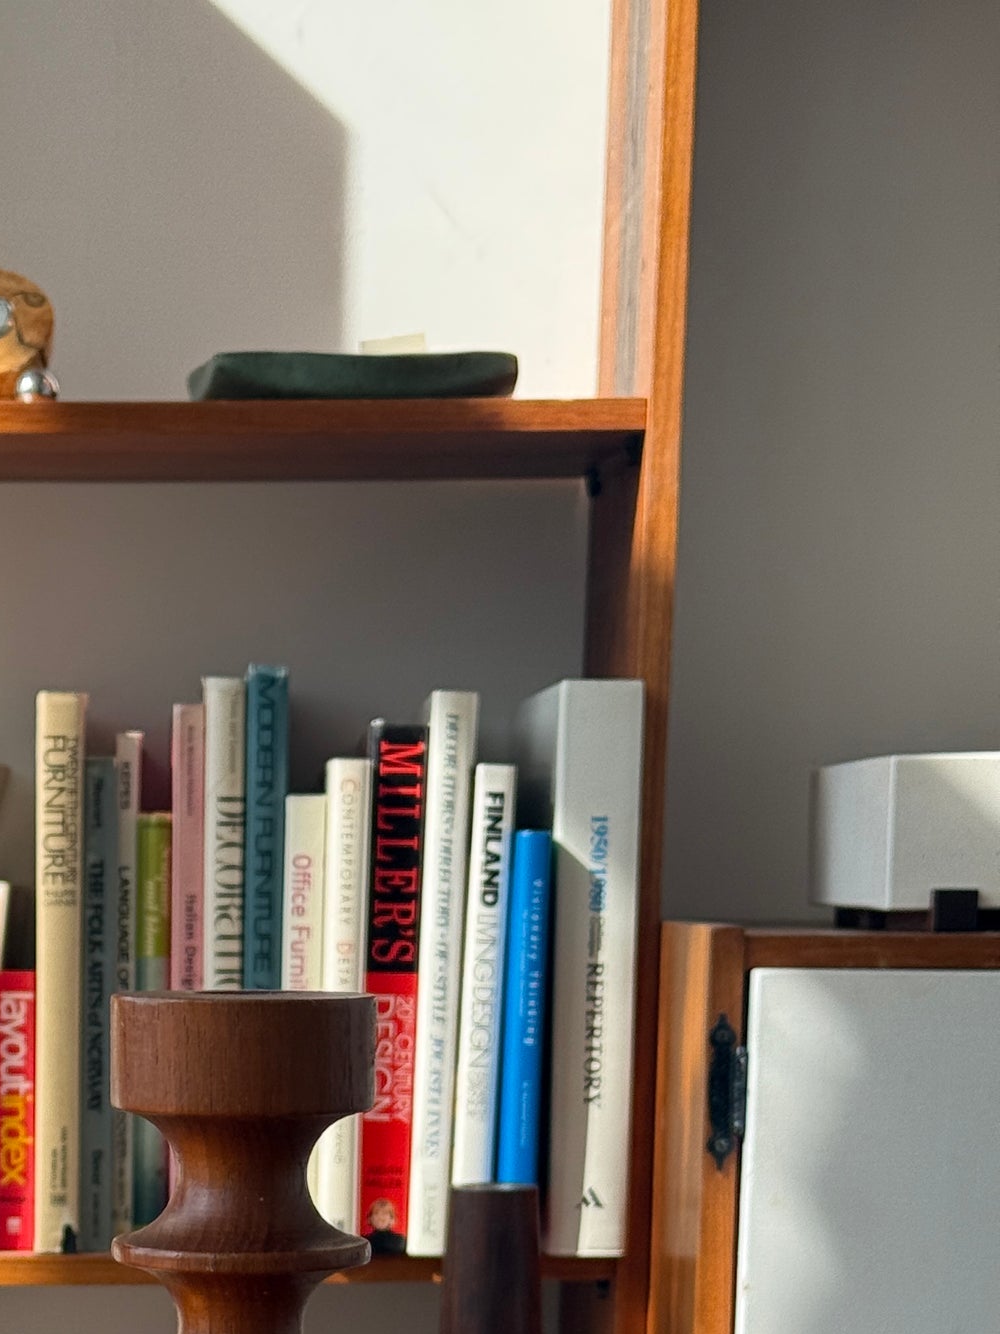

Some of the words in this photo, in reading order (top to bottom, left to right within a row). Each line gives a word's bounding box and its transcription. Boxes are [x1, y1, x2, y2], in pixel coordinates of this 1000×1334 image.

[255, 676, 276, 806] MODERN
[44, 734, 67, 885] FURNITURE
[119, 761, 131, 810] KEPES
[90, 858, 105, 898] THE
[214, 796, 244, 990] DECORATI
[291, 854, 313, 917] Office
[340, 778, 361, 925] CONTEMPORARY
[371, 740, 426, 964] MILLER'S
[480, 791, 505, 908] FINLAND
[89, 902, 103, 953] FOLK
[117, 865, 130, 964] LANGUAGE
[253, 816, 275, 971] FURNITURE
[527, 878, 545, 962] Visionary
[88, 959, 103, 1009] ARTS
[117, 968, 130, 990] OF
[523, 970, 543, 1046] Thinking
[469, 986, 494, 1069] DESIGN
[583, 961, 606, 1107] REPERTORY
[87, 1032, 103, 1114] NORWAY
[391, 1032, 413, 1123] CENTURY
